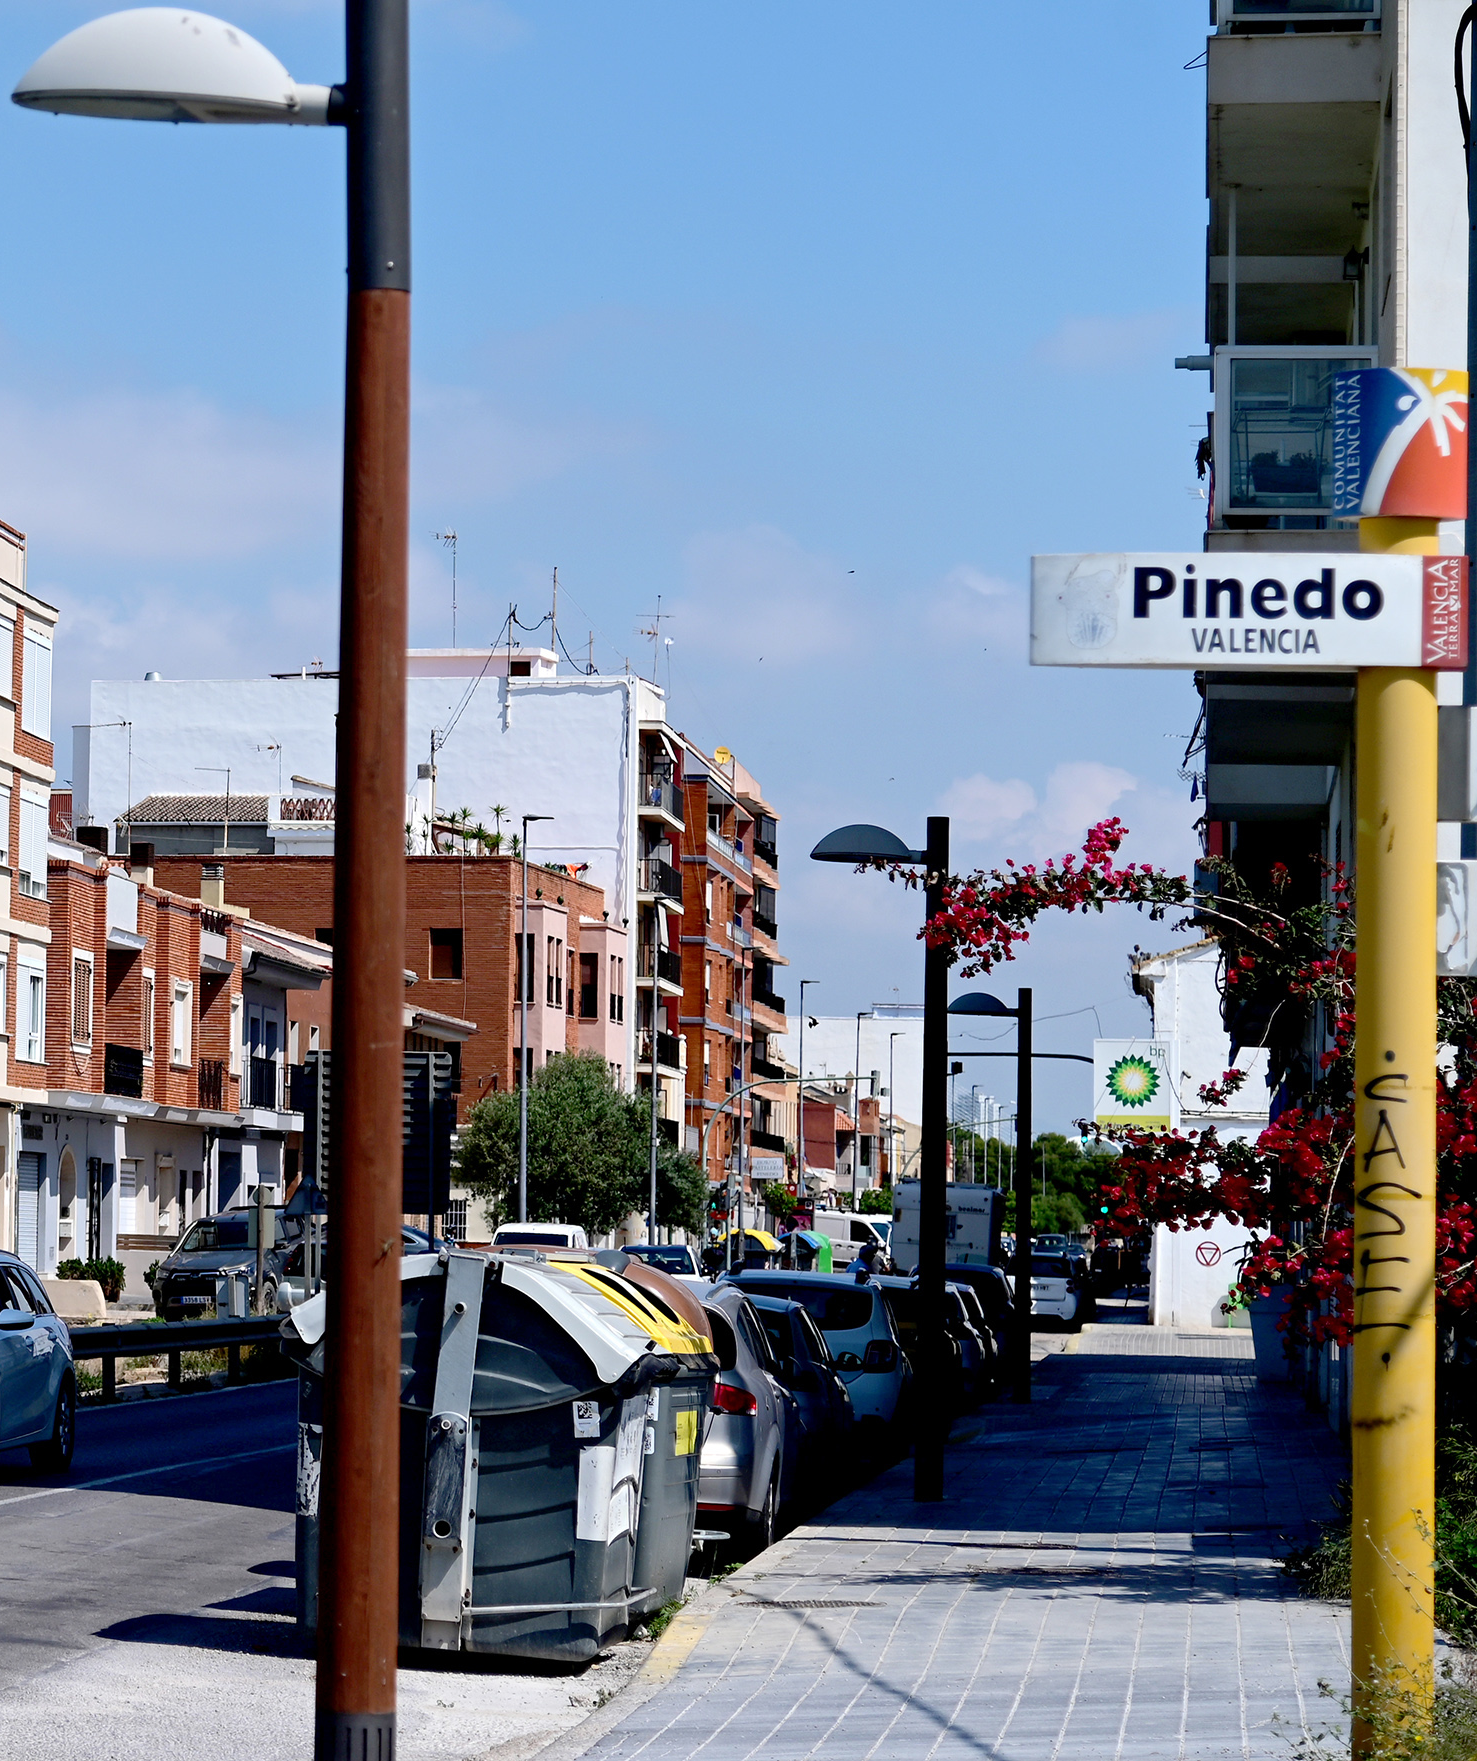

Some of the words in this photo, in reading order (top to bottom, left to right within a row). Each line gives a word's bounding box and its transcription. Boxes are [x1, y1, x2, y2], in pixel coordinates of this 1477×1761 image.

[1334, 377, 1346, 510] COMUNITAT
[1346, 374, 1362, 509] VALENCIANA
[1132, 563, 1385, 621] Pinedo
[1449, 558, 1459, 592] MAR
[1426, 559, 1450, 664] VALENCIA
[1448, 613, 1459, 660] TERRA
[1191, 627, 1321, 655] VALENCIA
[1149, 1045, 1166, 1059] bp
